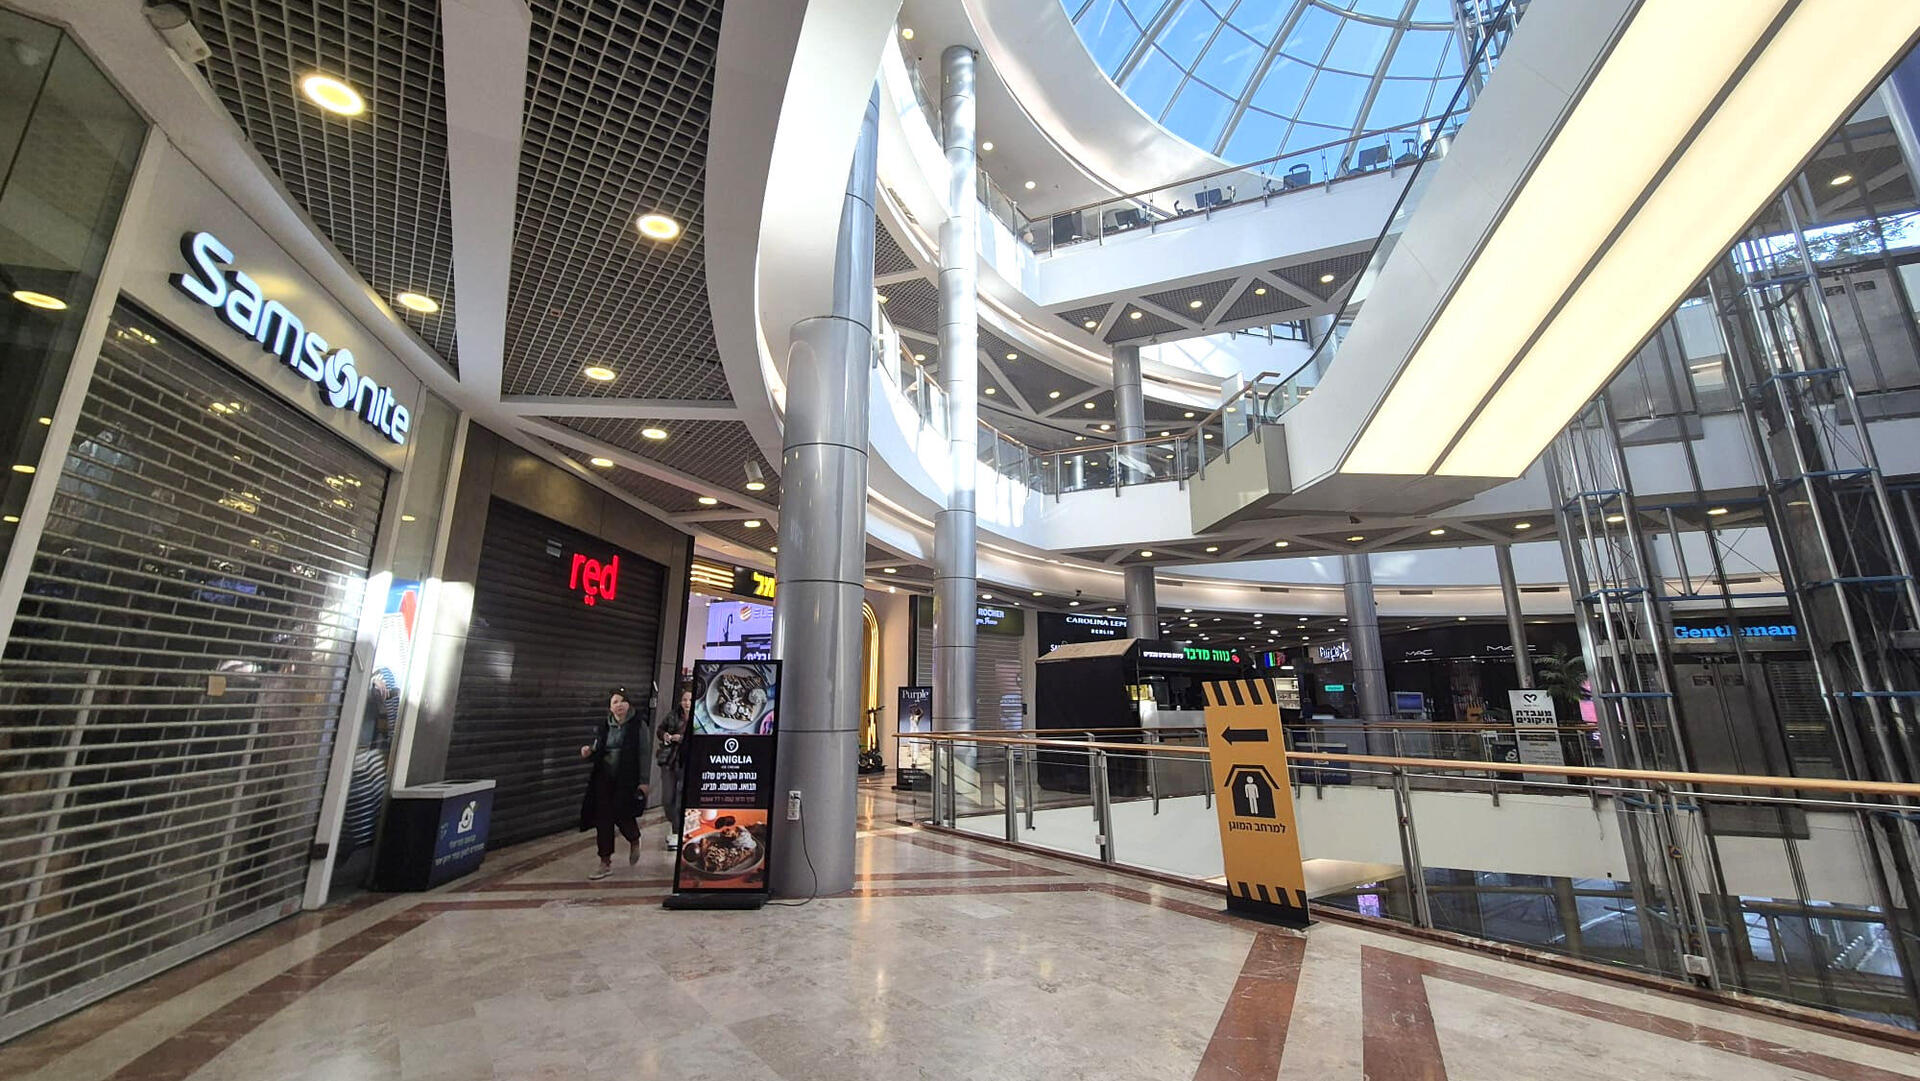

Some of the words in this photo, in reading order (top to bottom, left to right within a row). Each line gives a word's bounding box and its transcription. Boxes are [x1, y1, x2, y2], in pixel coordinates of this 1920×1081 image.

[172, 231, 411, 446] Samsonite
[569, 552, 619, 605] red
[1066, 616, 1109, 626] CAROLINA
[1673, 624, 1797, 638] Gentleman
[1184, 647, 1210, 660] מדבר
[1212, 650, 1230, 662] נווה
[902, 689, 929, 702] Purple
[1516, 717, 1553, 725] תיקונים
[709, 755, 752, 764] VANIGLIA
[1229, 821, 1253, 832] המוגן
[1255, 822, 1286, 833] למרחב
